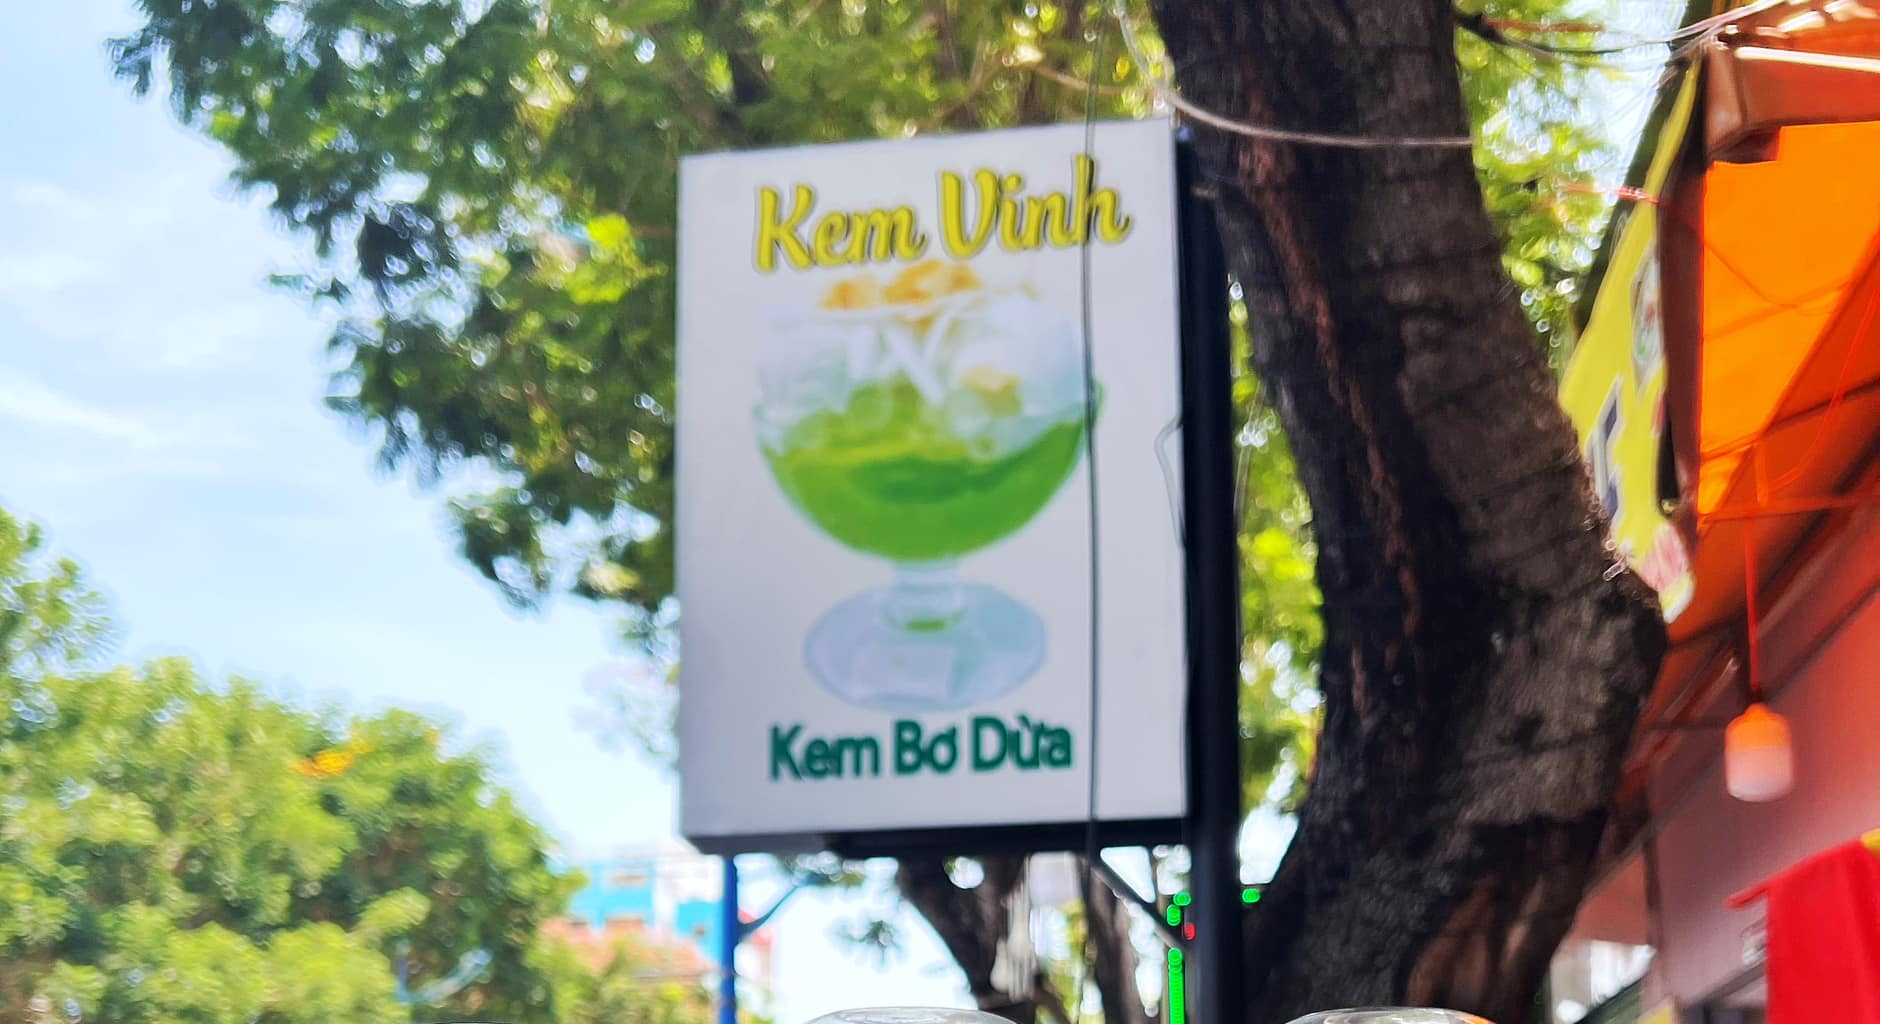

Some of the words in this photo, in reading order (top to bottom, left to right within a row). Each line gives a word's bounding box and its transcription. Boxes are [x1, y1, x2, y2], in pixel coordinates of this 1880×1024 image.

[756, 185, 926, 272] Kem
[940, 153, 1131, 260] Vinh
[770, 723, 881, 781] Kem
[894, 719, 959, 774] Bơ
[971, 714, 1072, 771] Dừa
